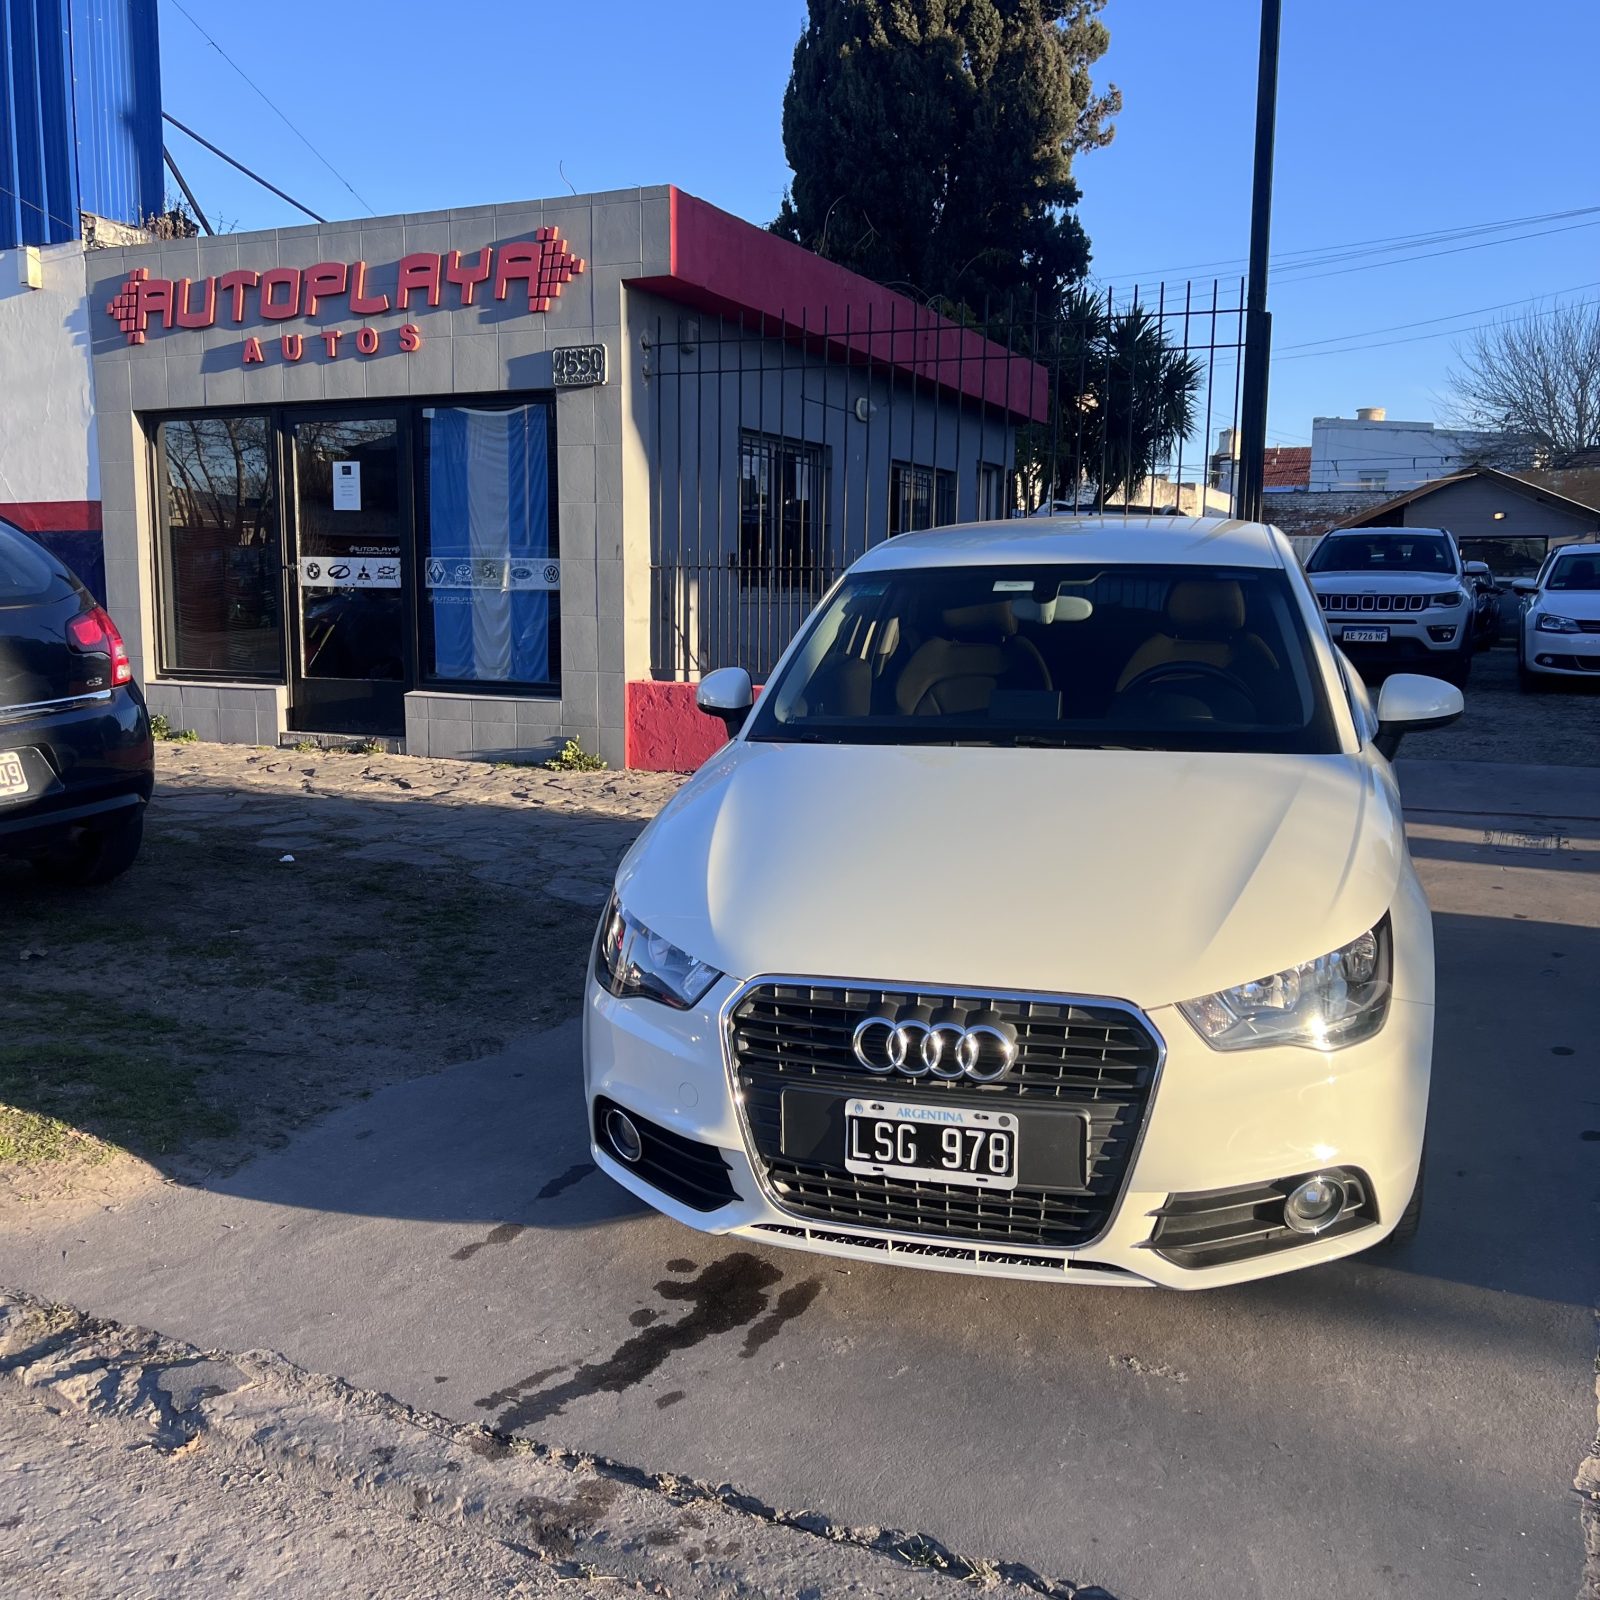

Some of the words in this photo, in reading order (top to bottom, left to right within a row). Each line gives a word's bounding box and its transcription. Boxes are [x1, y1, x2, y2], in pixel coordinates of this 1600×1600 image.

[136, 241, 543, 330] AUTOPLAYA
[242, 323, 421, 364] AUTOS
[1345, 632, 1356, 640] AE
[1358, 632, 1374, 640] 726
[896, 1107, 964, 1123] ARGENTINA
[852, 1118, 918, 1164] LSG
[941, 1127, 1010, 1174] 978
